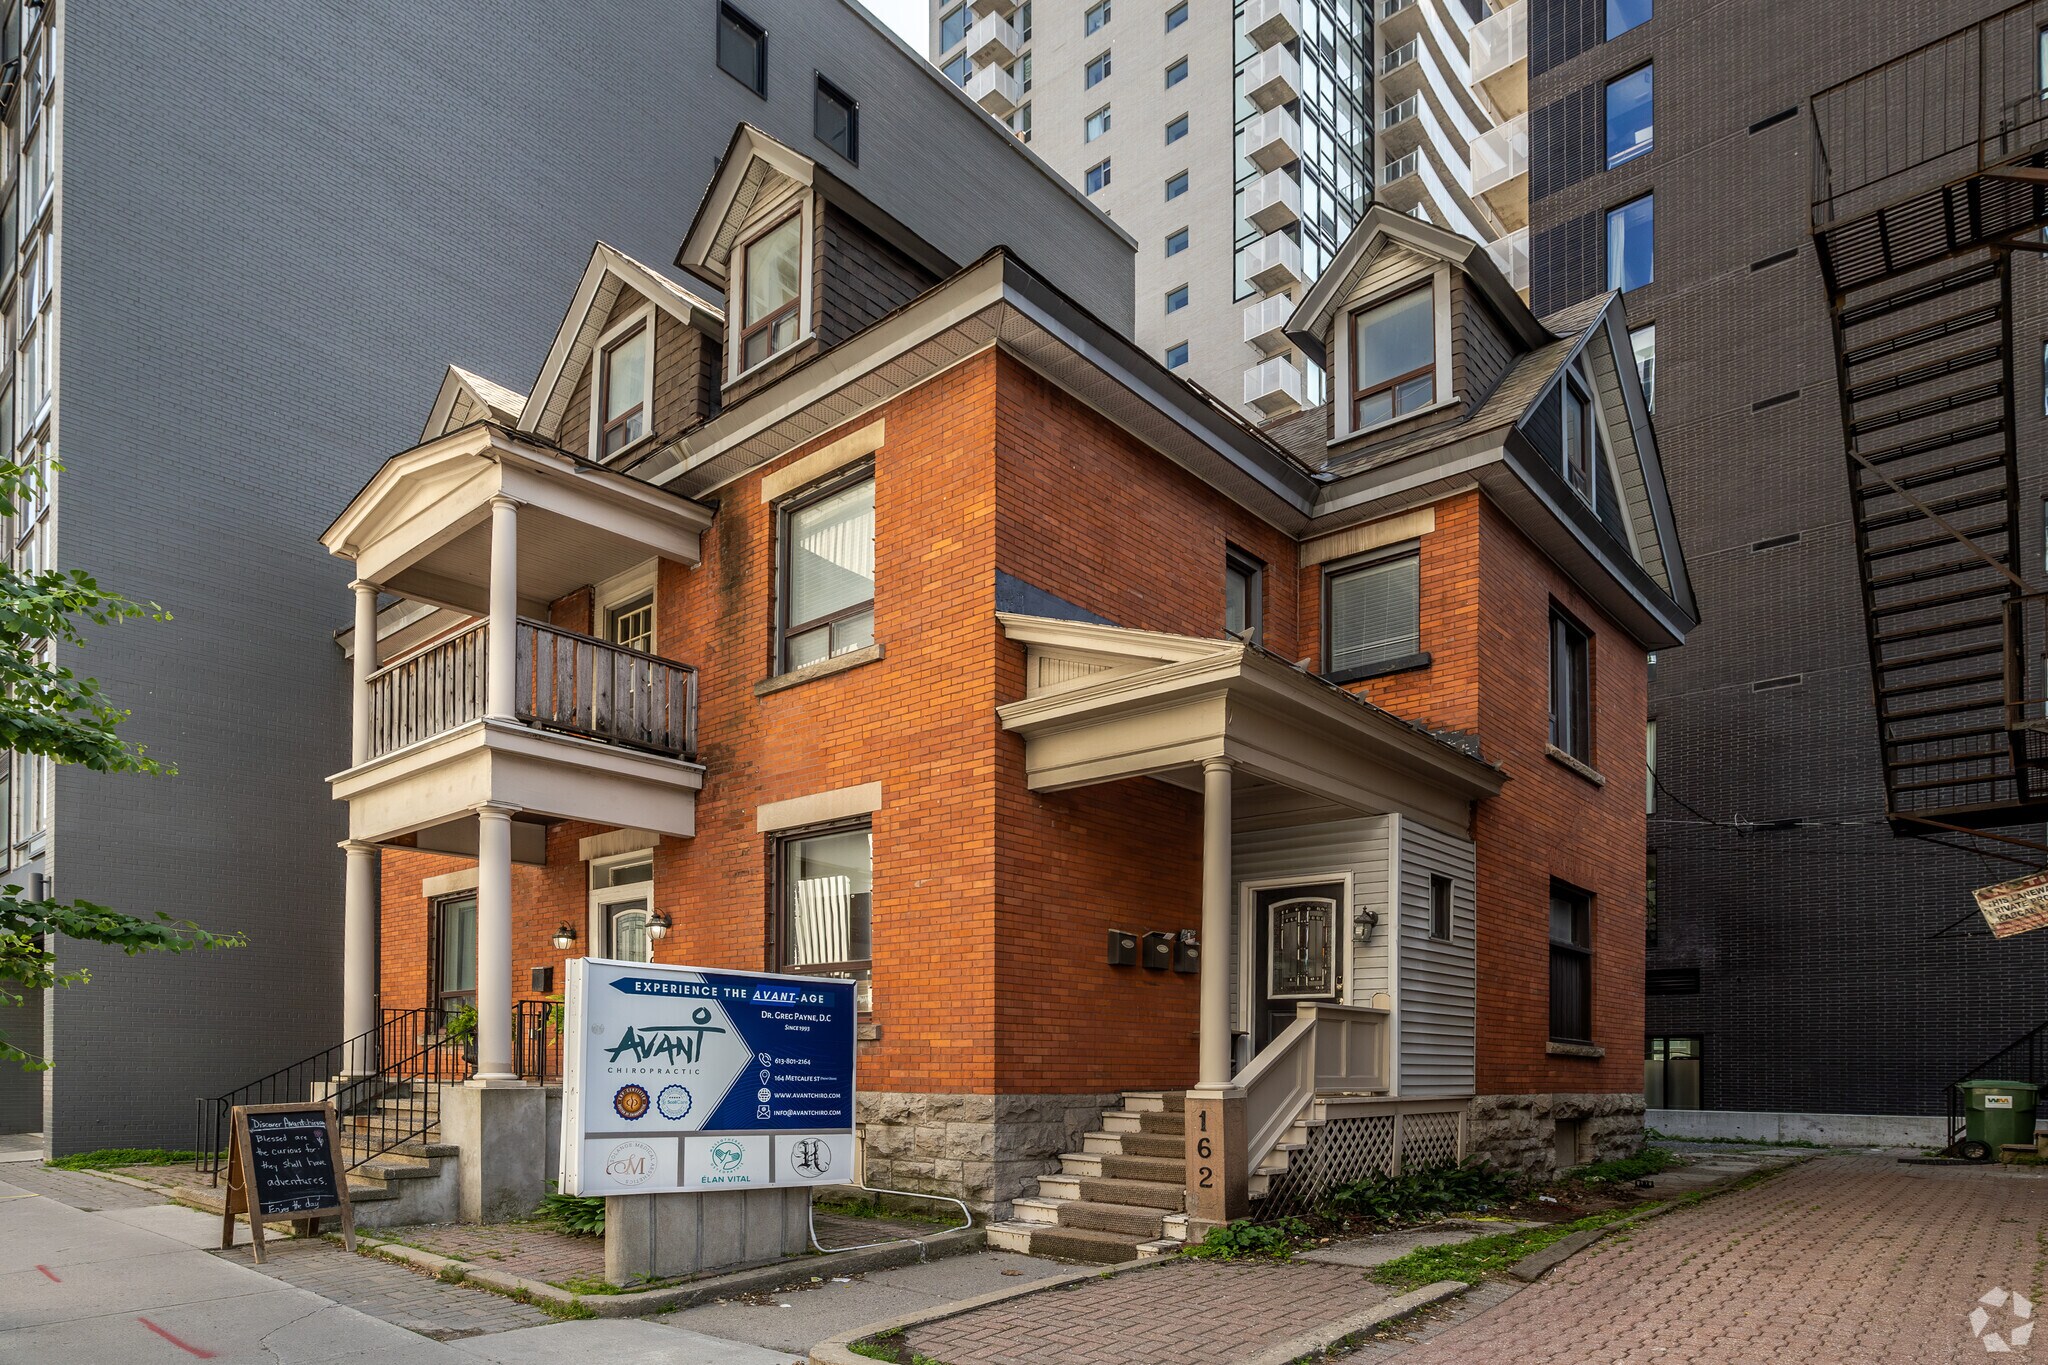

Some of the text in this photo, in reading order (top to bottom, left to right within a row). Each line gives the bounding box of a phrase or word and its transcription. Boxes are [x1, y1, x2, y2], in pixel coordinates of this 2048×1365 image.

[635, 981, 824, 1004] EXPERIENCE THE AVANT-AGE
[819, 1014, 831, 1022] D.C
[774, 1057, 811, 1066] 613-801-2164
[607, 1067, 700, 1075] CHIROPRACTIC
[773, 1109, 842, 1117] INFO@AVANTCHIRO.COM
[251, 1118, 282, 1129] Discover
[255, 1133, 287, 1143] Blessed
[256, 1147, 269, 1157] the
[271, 1147, 302, 1156] curious
[635, 1143, 655, 1161] MEDICAL
[261, 1160, 278, 1172] they
[306, 1157, 327, 1167] have
[625, 1162, 655, 1184] AESTHETICS
[267, 1174, 328, 1187] adventures.
[701, 1175, 751, 1184] ÉLAN VITAL
[268, 1197, 320, 1213] Enjoy the day
